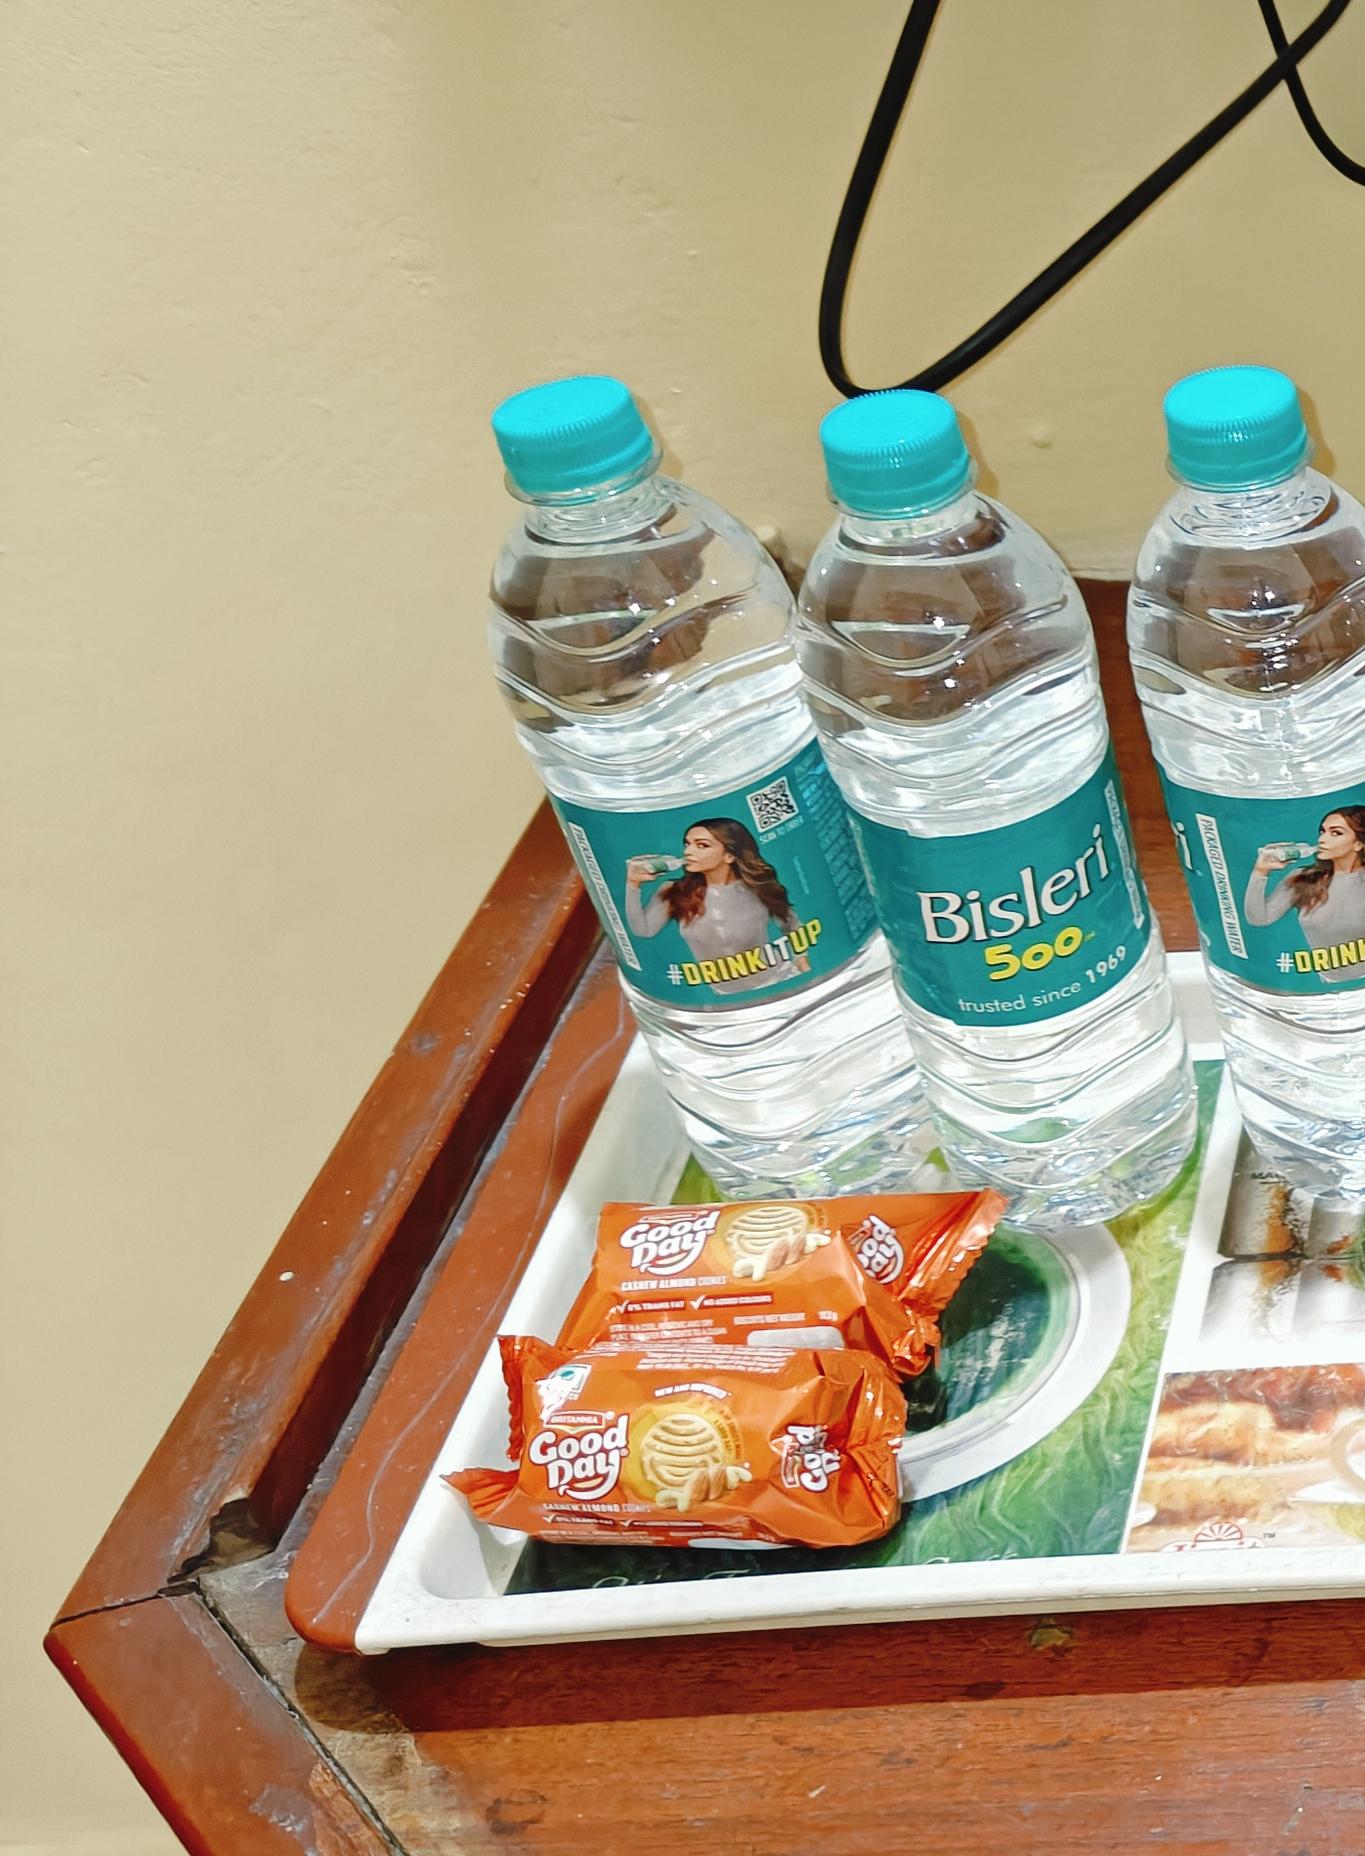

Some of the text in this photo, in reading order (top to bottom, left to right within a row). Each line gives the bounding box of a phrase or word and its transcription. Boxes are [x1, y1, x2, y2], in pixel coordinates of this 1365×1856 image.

[917, 824, 1109, 943] Bisleri
[1201, 818, 1243, 954] PACKAGED DRINKING WATER
[667, 919, 823, 987] #DRINKITUP
[958, 945, 1126, 1013] trusted since 1969
[984, 926, 1083, 981] 500
[620, 1211, 720, 1248] Good
[631, 1230, 707, 1276] Day
[529, 1414, 629, 1465] Good
[550, 1415, 598, 1424] BRITANNIA
[548, 1449, 622, 1500] Day
